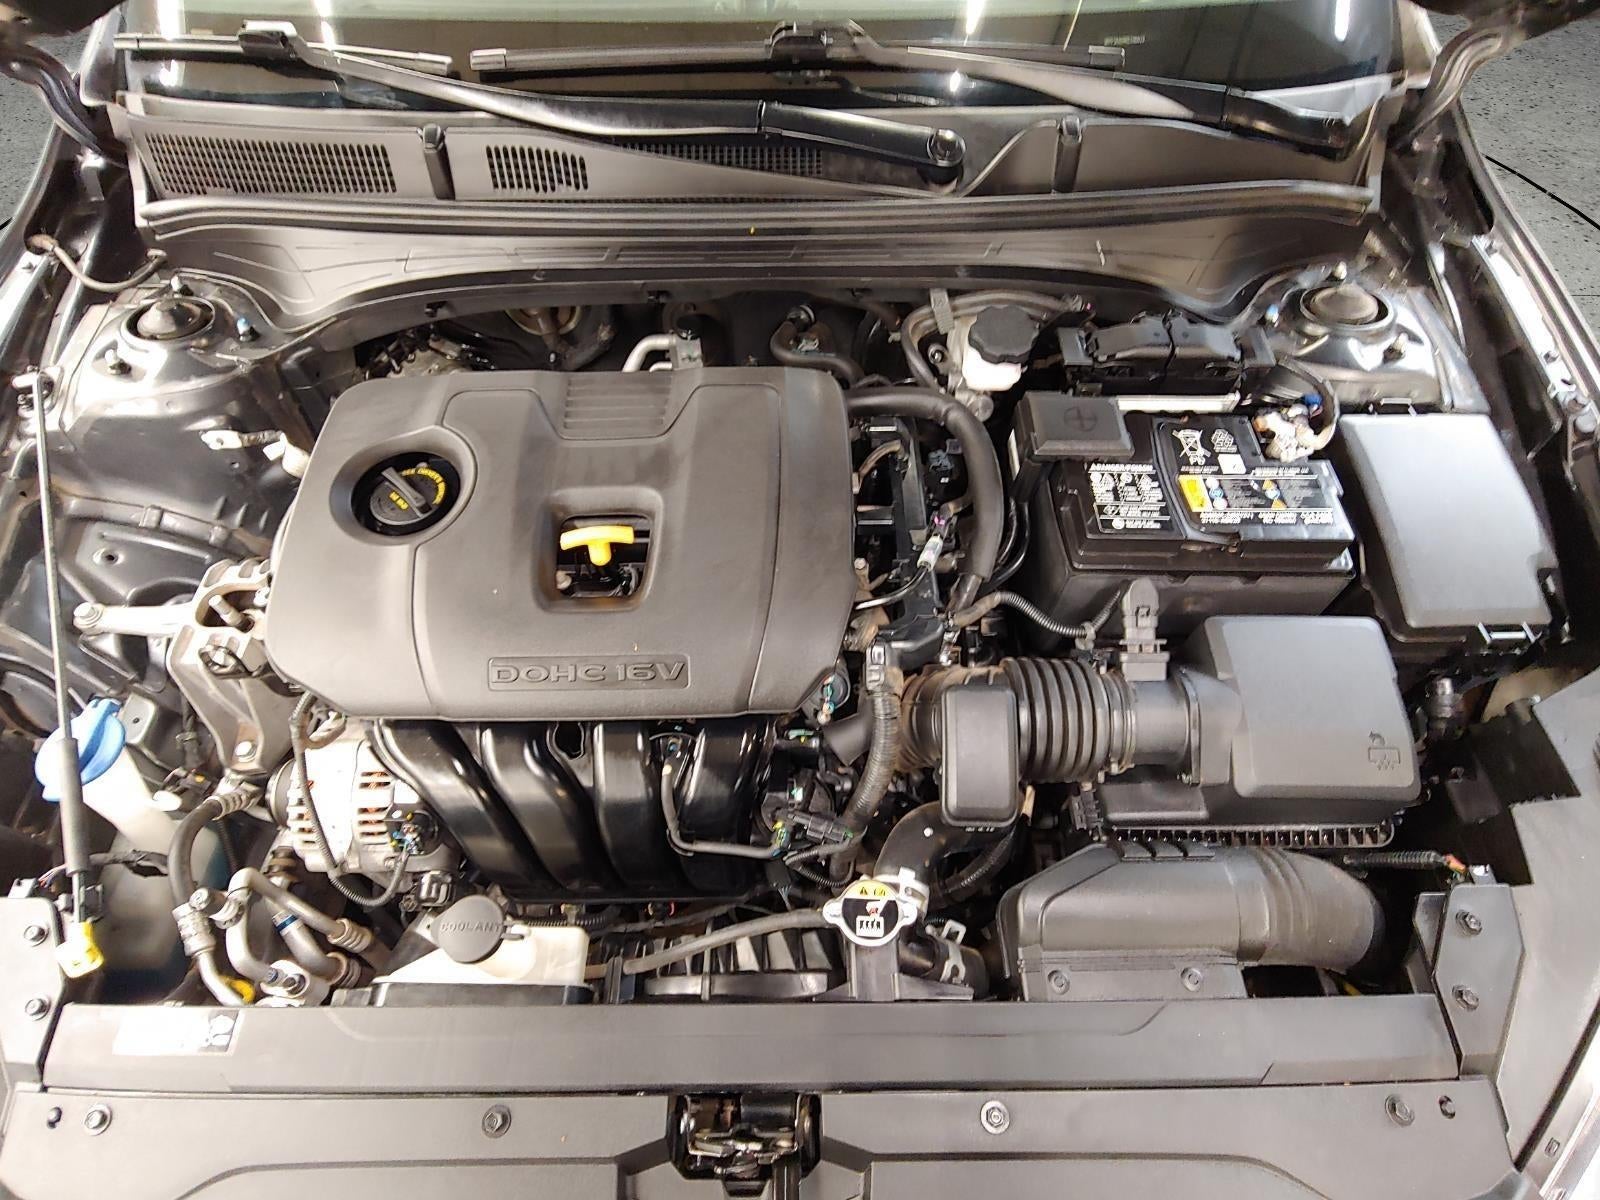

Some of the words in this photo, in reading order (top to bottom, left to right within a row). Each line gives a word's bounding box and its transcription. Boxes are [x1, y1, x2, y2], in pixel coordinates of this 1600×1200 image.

[491, 664, 606, 683] DOHC
[615, 662, 686, 682] 16V
[440, 920, 502, 933] COOLANT
